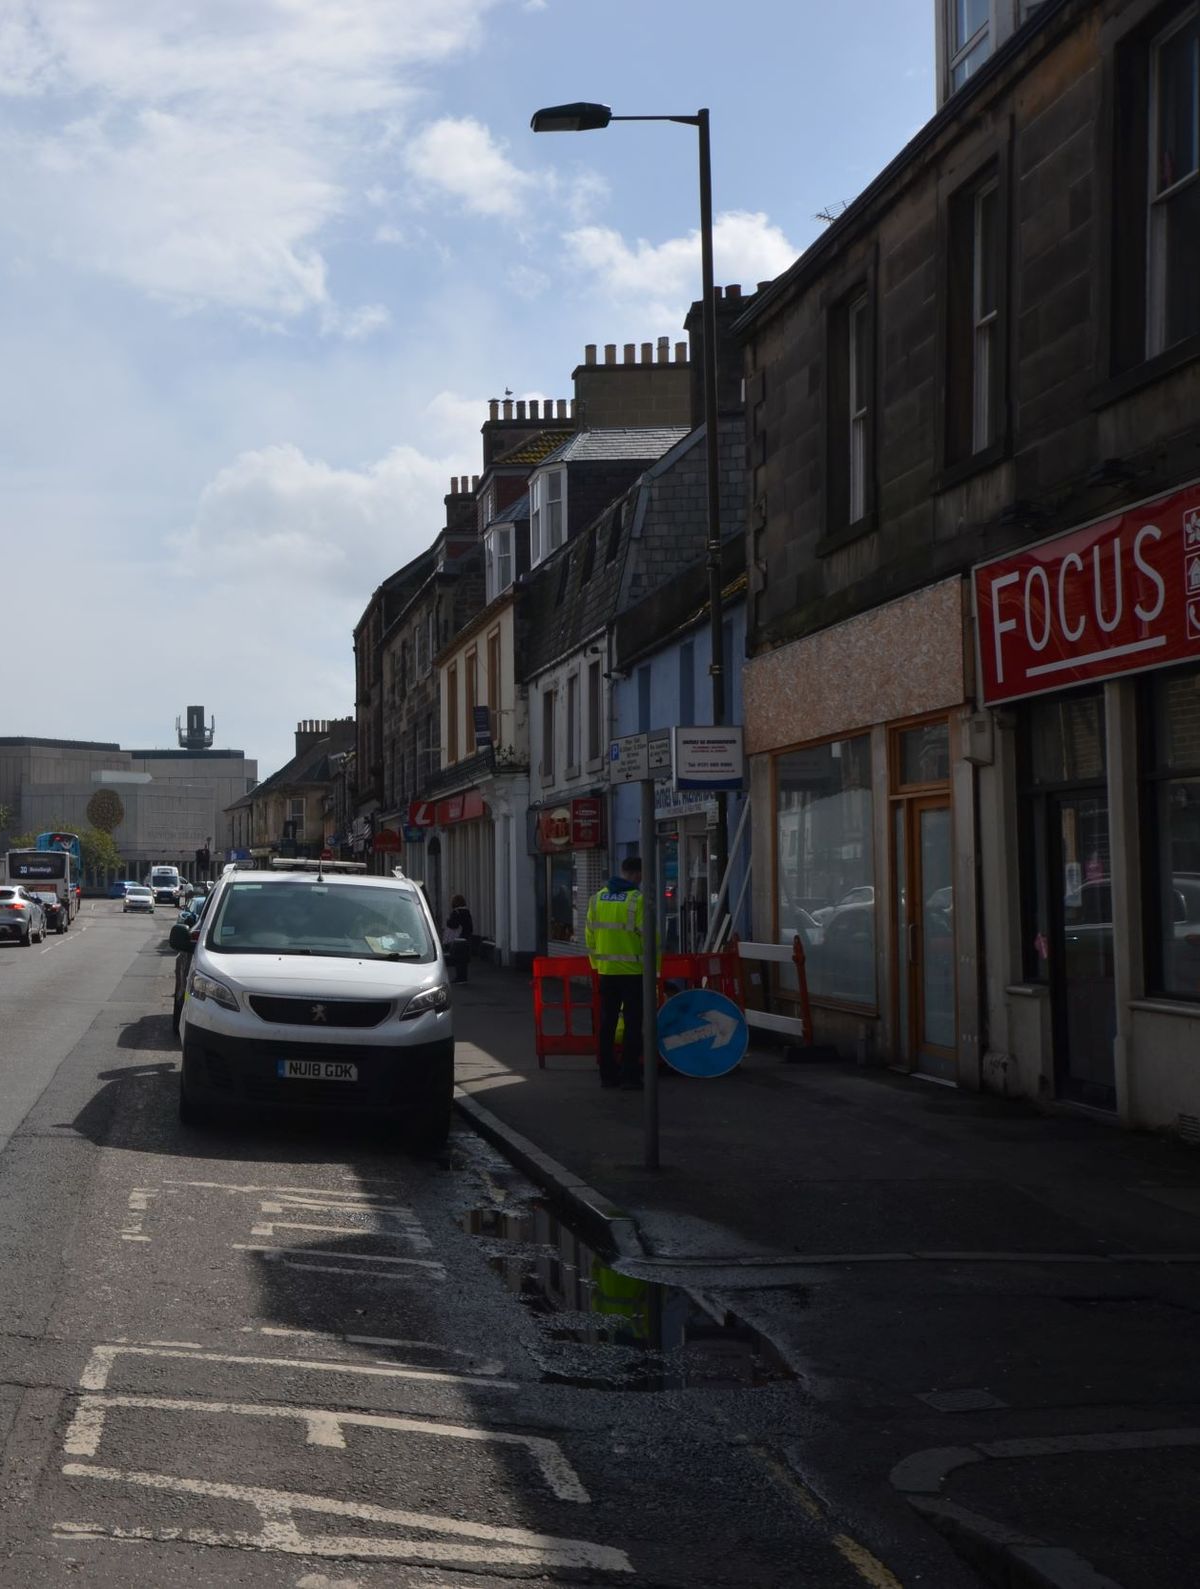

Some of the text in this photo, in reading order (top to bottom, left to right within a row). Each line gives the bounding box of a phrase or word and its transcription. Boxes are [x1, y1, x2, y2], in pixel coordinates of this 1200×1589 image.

[991, 524, 1166, 683] FOCUS
[601, 892, 626, 901] GAS
[325, 1063, 353, 1078] GDK
